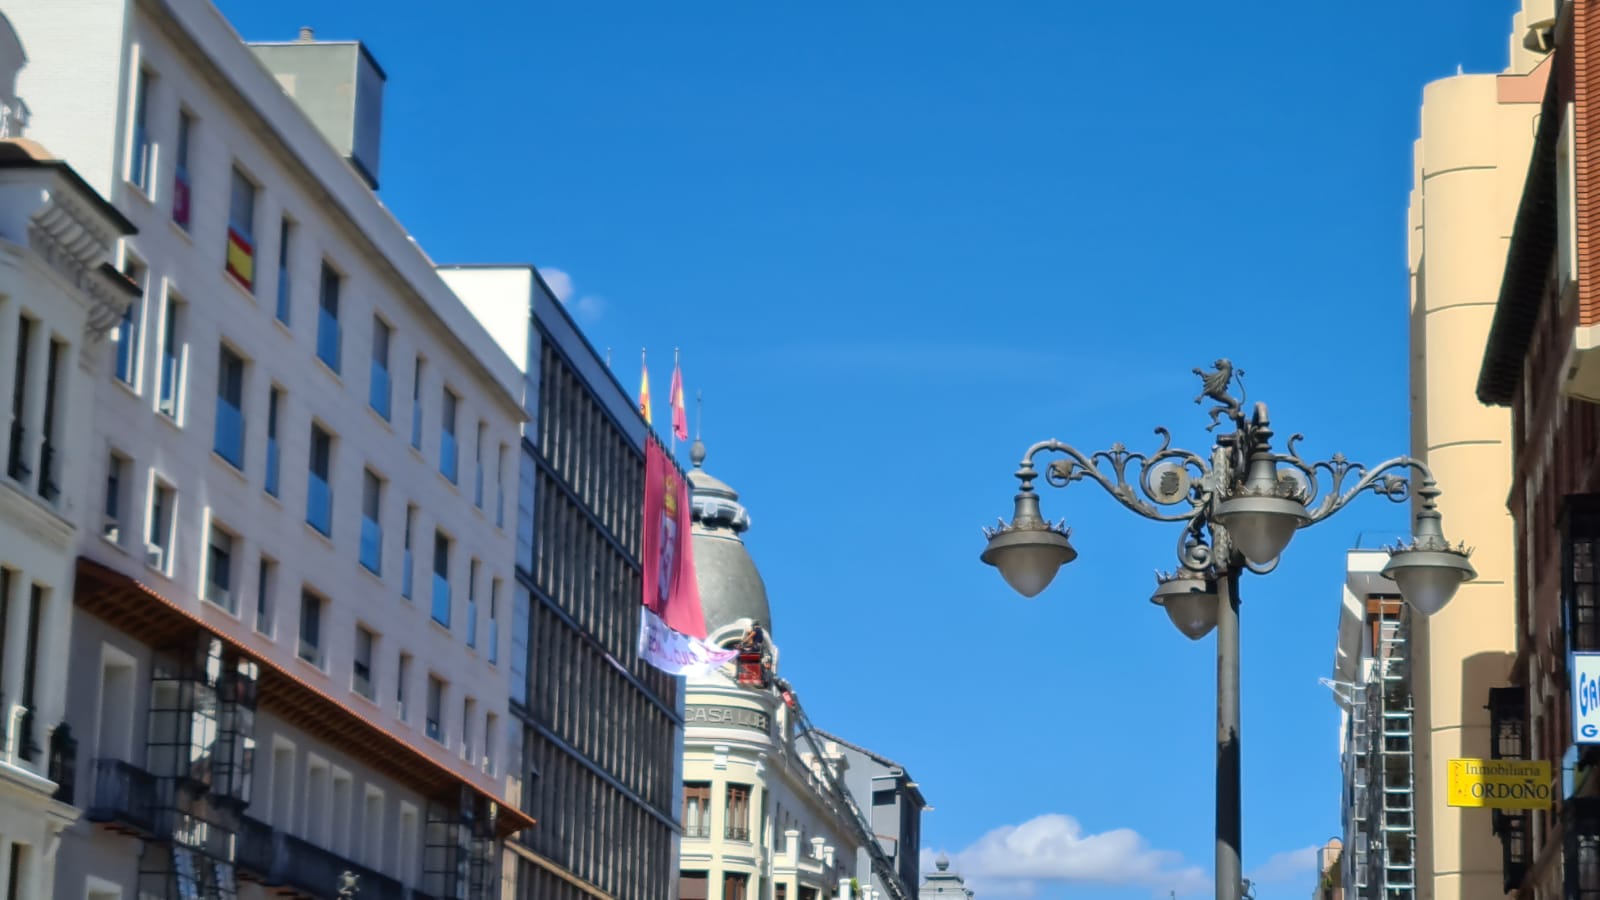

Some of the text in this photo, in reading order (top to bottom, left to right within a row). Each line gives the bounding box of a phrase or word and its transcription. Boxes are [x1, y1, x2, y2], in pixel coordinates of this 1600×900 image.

[684, 707, 733, 723] CASA
[1465, 761, 1541, 777] Inmobiliaria
[1471, 779, 1549, 800] ORDOÑO
